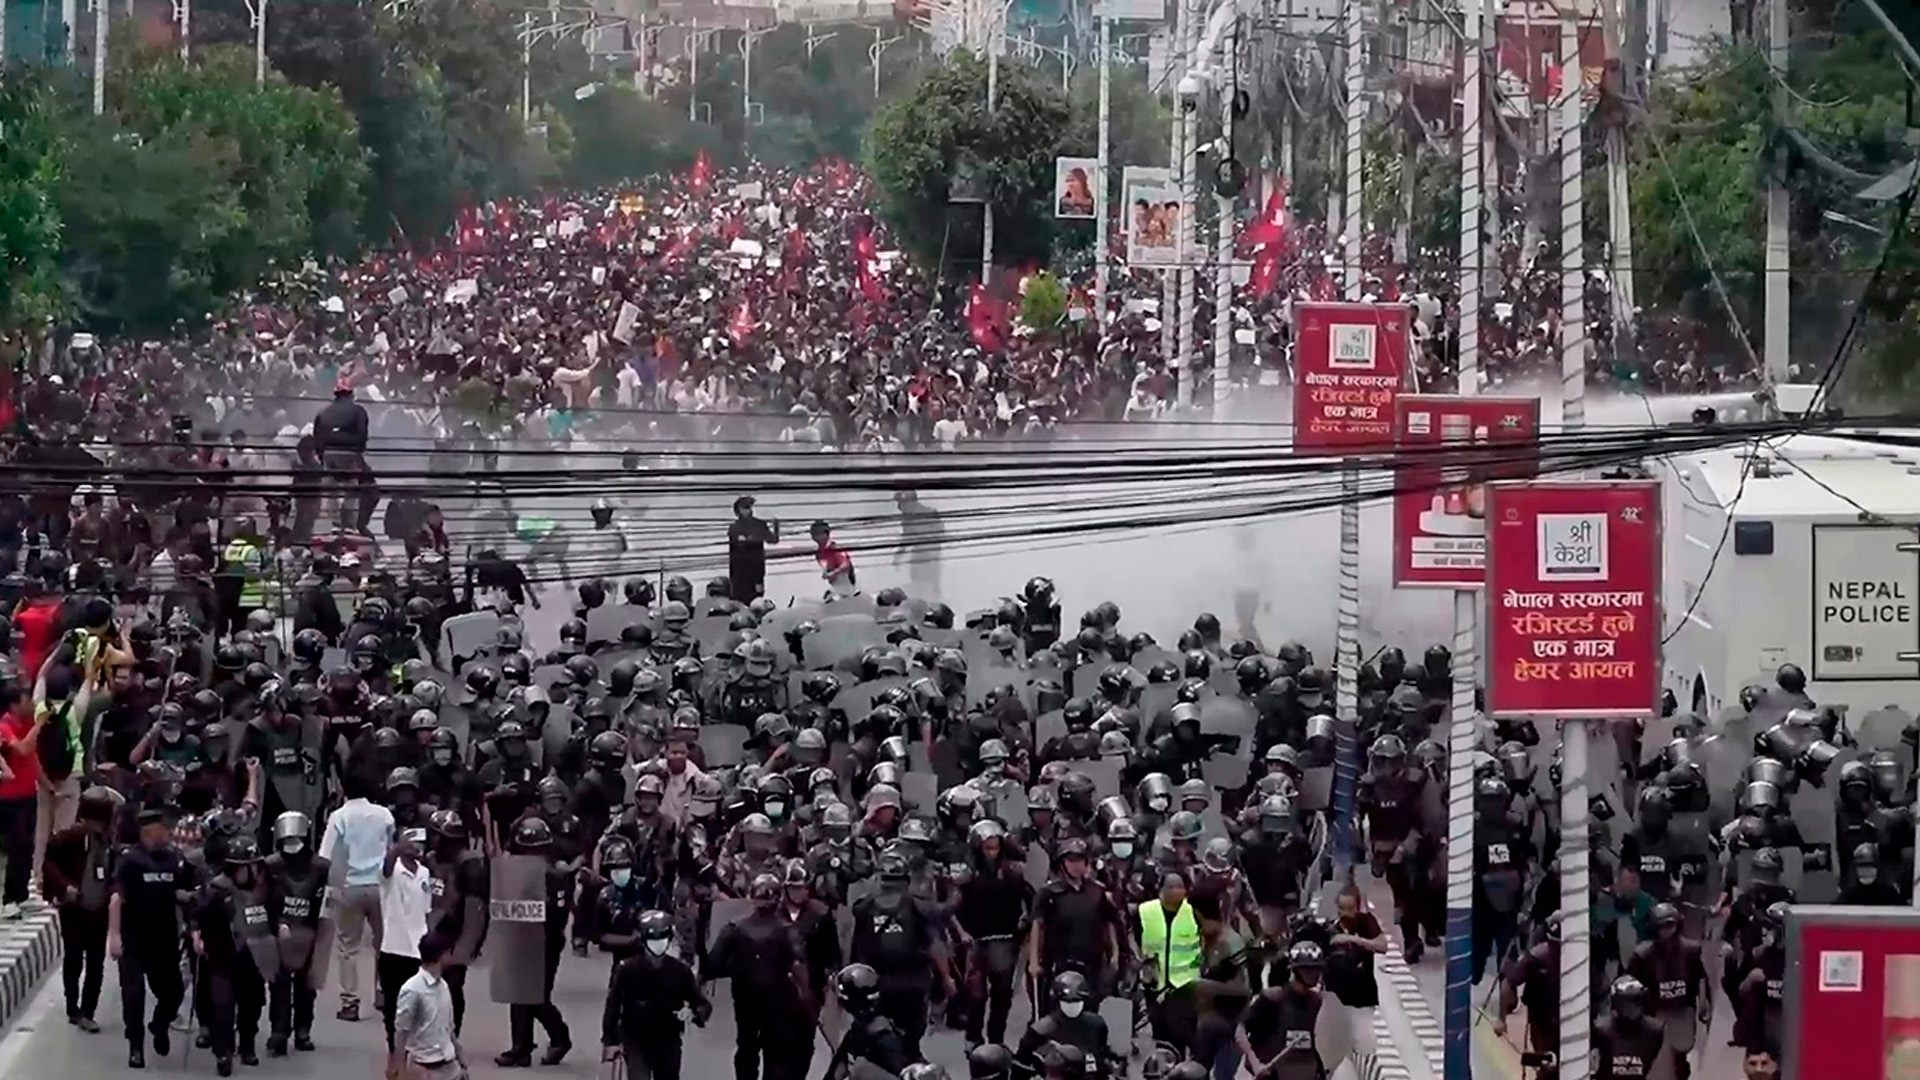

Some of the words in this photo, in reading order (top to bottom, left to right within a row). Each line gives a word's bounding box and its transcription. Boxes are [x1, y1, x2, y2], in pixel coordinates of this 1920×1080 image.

[1323, 405, 1347, 418] एक
[1349, 405, 1378, 419] मात्र
[1570, 520, 1592, 543] श्री
[1554, 542, 1592, 564] केश
[1503, 588, 1554, 608] नेपाल
[1559, 591, 1644, 608] सरकारमा
[1829, 582, 1906, 600] NEPAL
[1511, 611, 1595, 635] रजिस्टर्ड
[1602, 610, 1636, 637] हुने
[1824, 605, 1910, 623] POLICE
[1533, 639, 1568, 658] एक
[1573, 639, 1616, 657] मात्र
[1513, 657, 1563, 681] हेयर
[1569, 661, 1636, 680] आयल
[511, 902, 543, 918] POLICE
[1612, 1056, 1643, 1065] NEPAL
